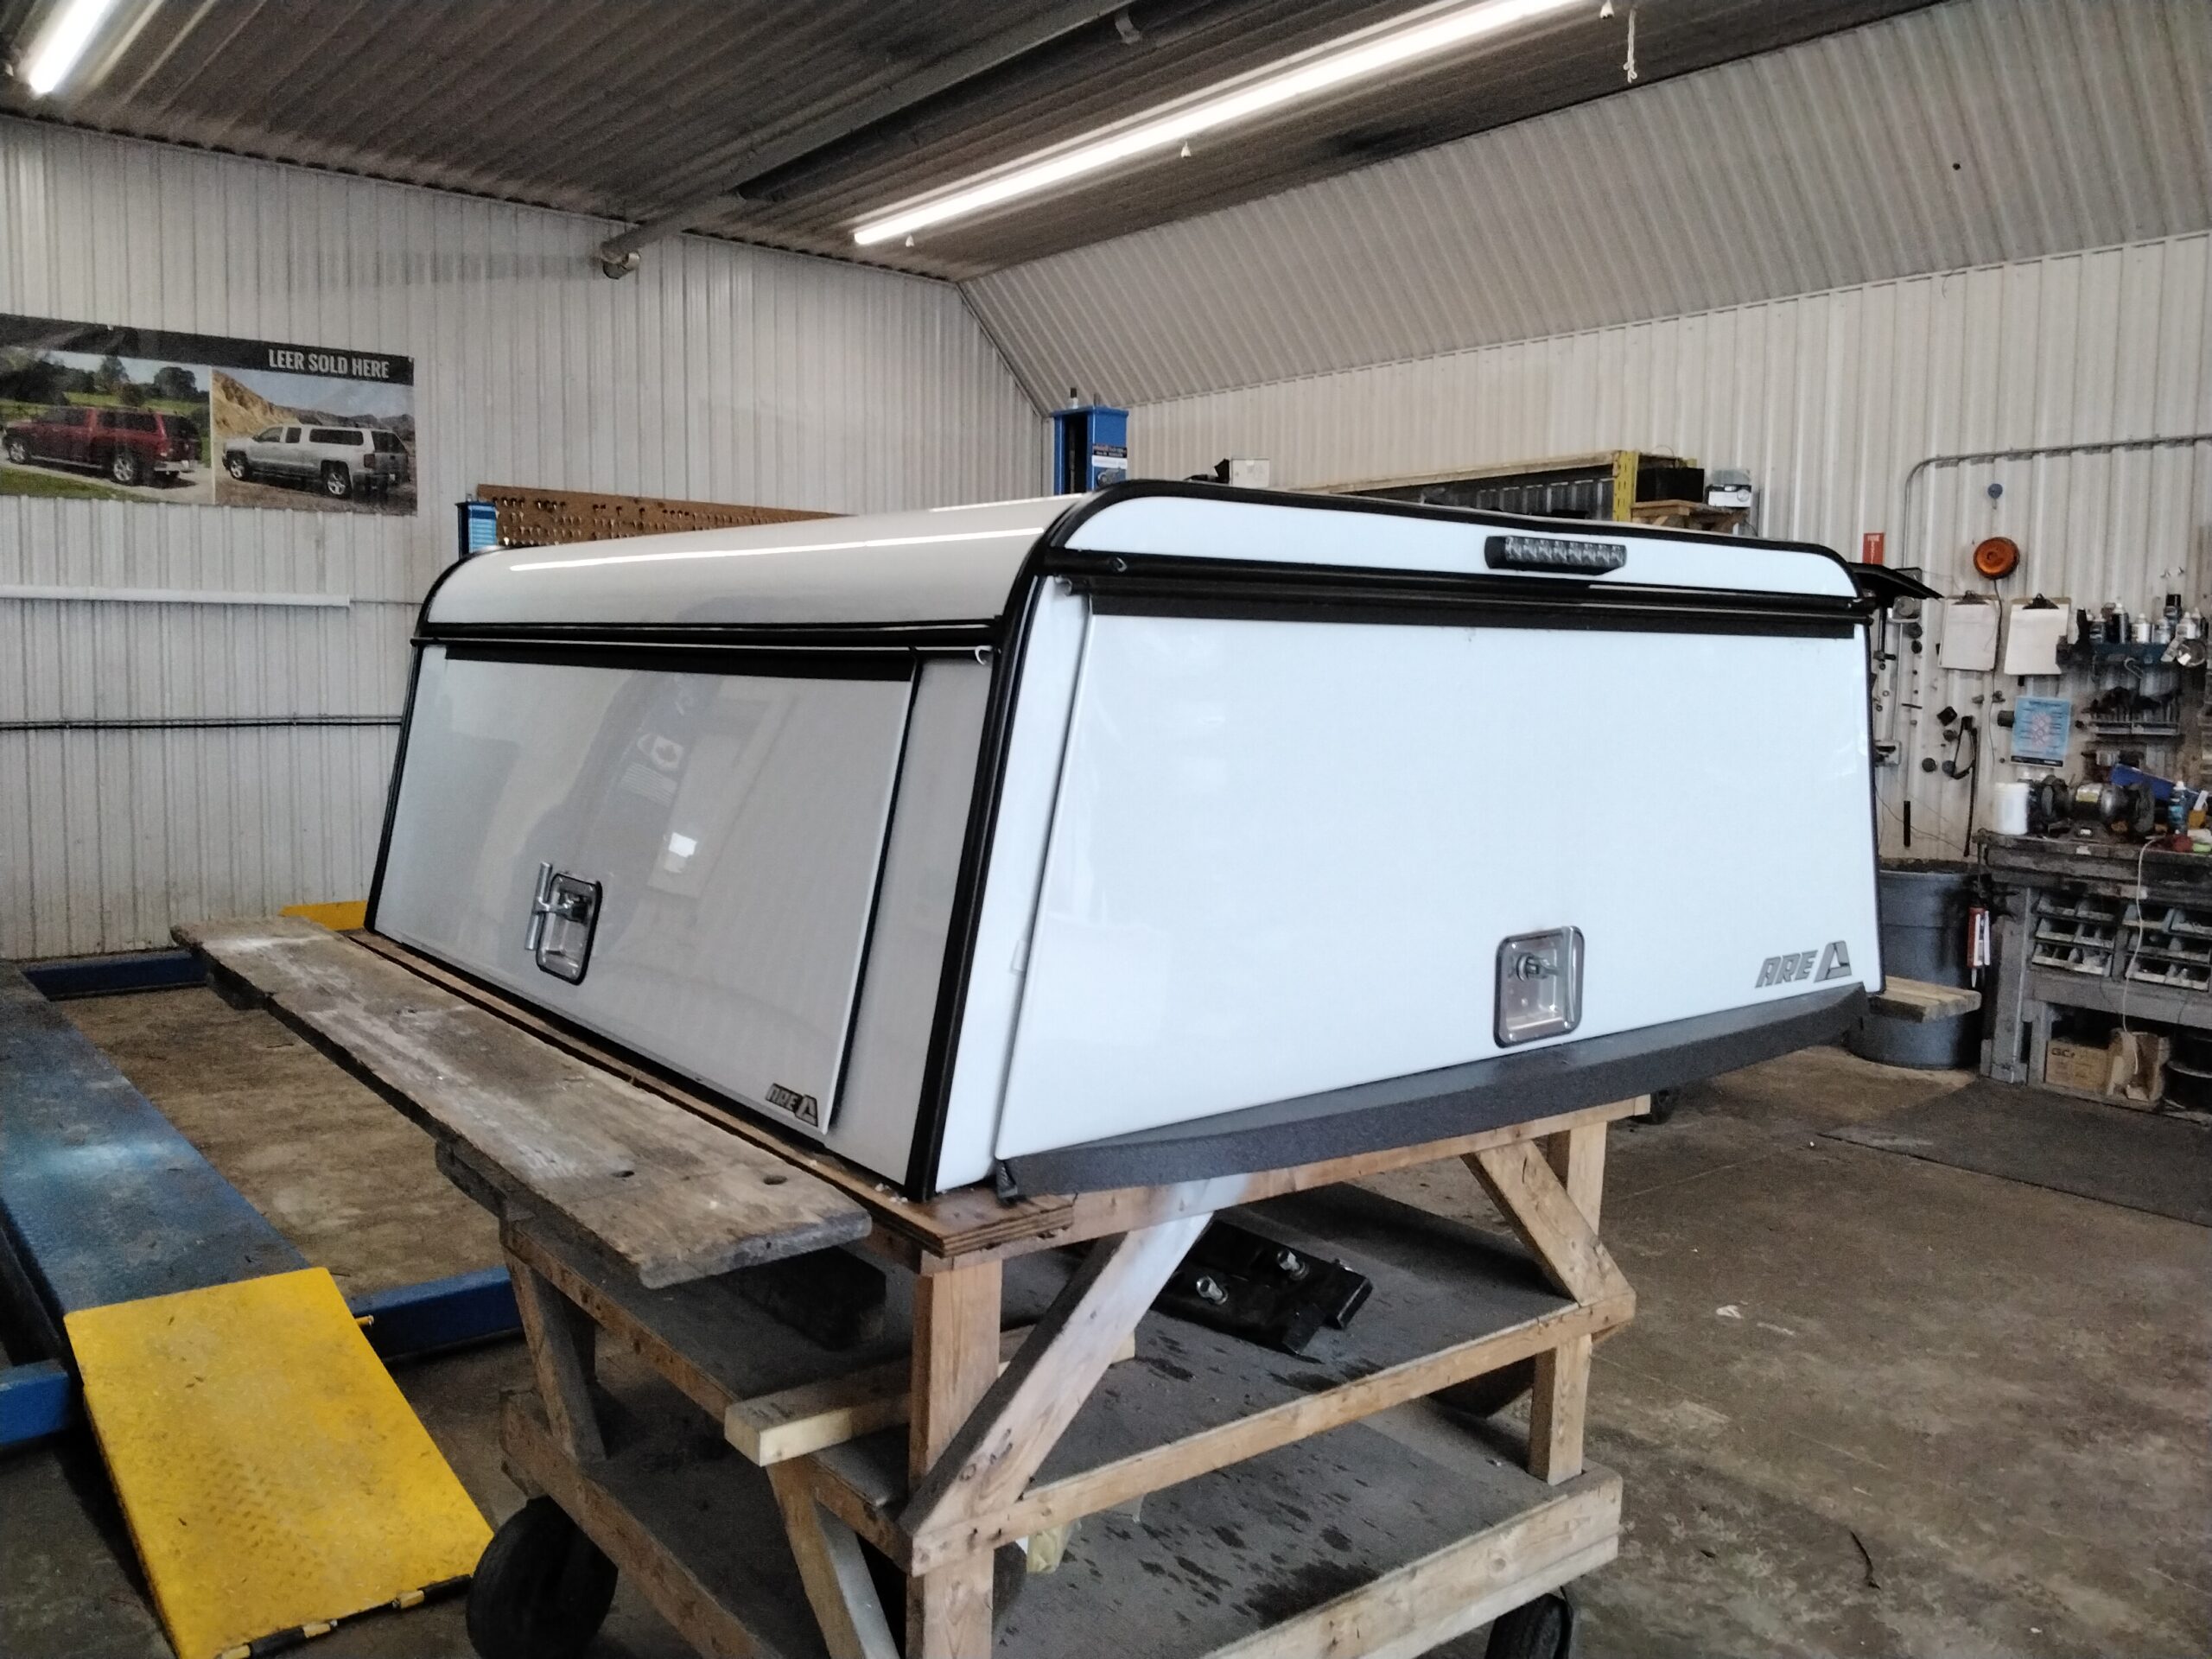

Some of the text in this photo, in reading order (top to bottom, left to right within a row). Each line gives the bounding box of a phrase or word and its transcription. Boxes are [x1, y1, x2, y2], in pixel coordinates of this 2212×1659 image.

[268, 348, 390, 378] LEER SOLD HERE
[1755, 950, 1818, 988] ARE
